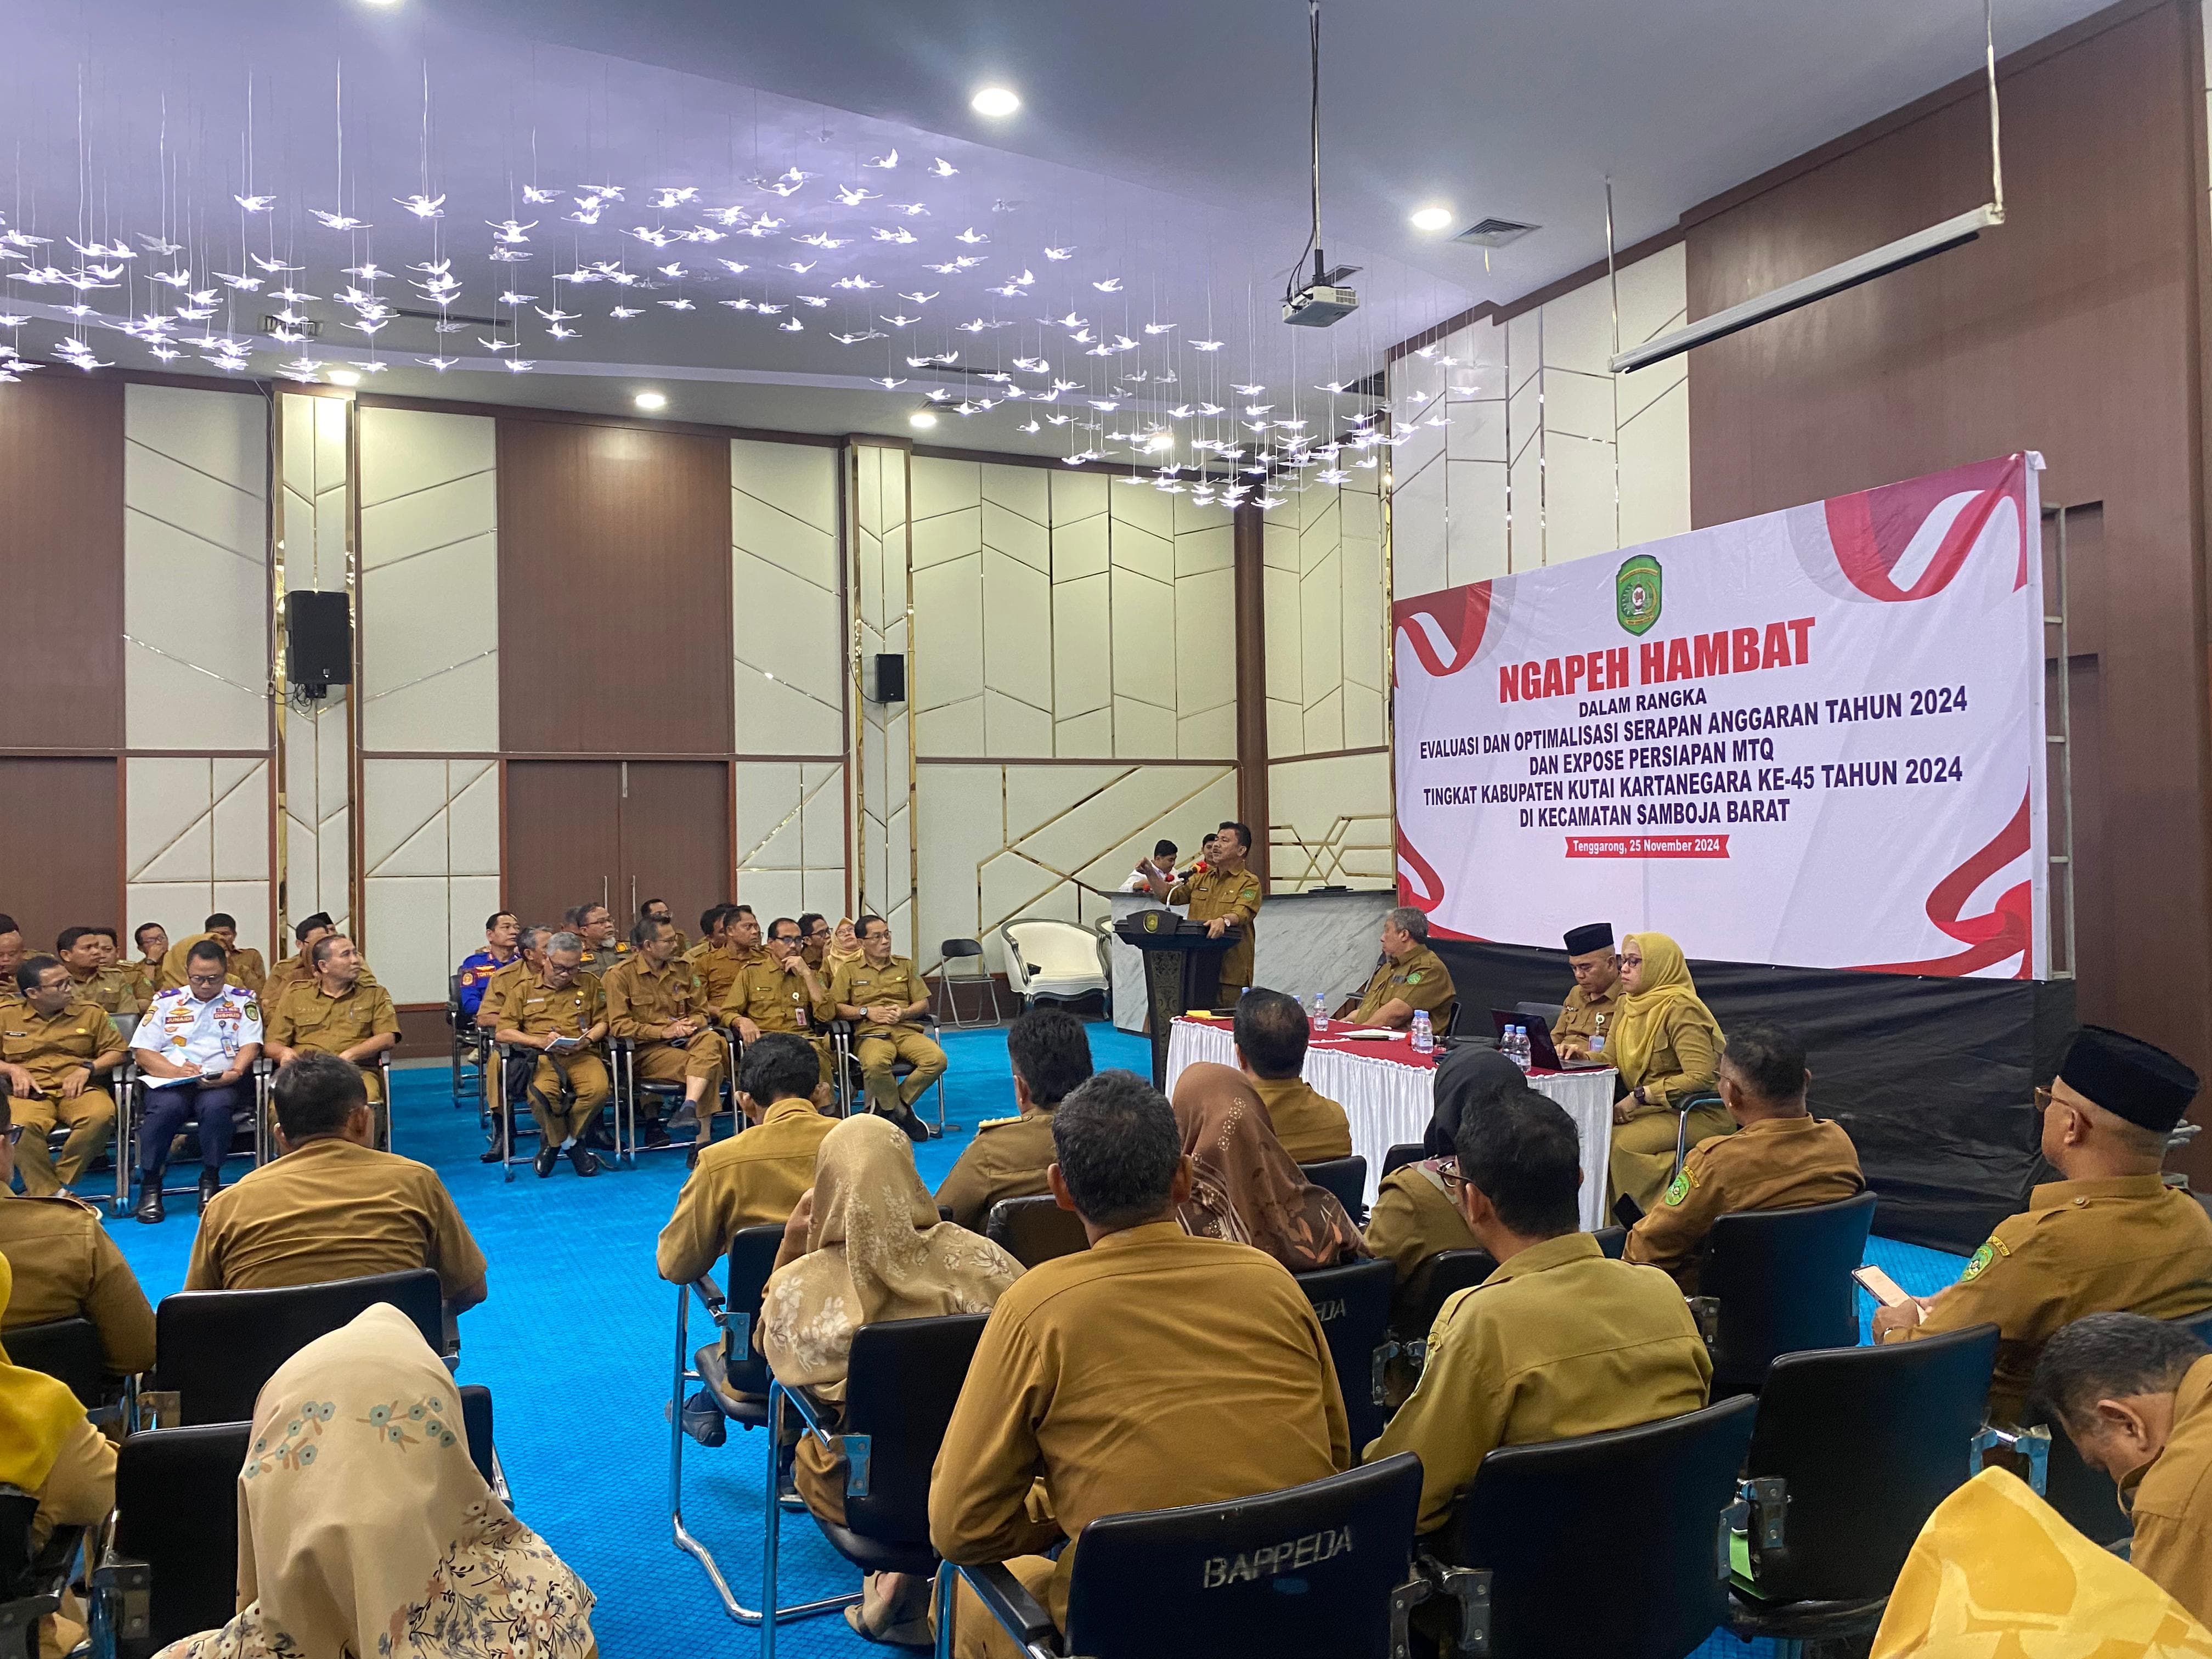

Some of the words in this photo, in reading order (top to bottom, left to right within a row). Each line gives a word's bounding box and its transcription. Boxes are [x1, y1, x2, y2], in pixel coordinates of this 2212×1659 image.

[1500, 647, 1629, 703] NGAPEH
[1640, 617, 1815, 685] HAMBAT
[1420, 736, 1479, 759] EVALUASI
[1483, 733, 1510, 754] DAN
[1514, 722, 1618, 751] OPTIMALISASI
[1624, 713, 1702, 742] SERAPAN
[1708, 701, 1818, 735] ANGGARAN
[1825, 692, 1901, 724] TAHUN
[1910, 685, 1967, 716] 2024
[1579, 696, 1630, 718] DALAM
[1636, 687, 1707, 712] RANGKA
[1530, 754, 1559, 776] DAN
[1564, 749, 1624, 774] EXPOSE
[1629, 741, 1726, 769] PERSIAPAN
[1733, 737, 1774, 762] MTQ
[1423, 786, 1477, 806] TINGKAT
[1481, 781, 1563, 804] KABUPATEN
[1568, 777, 1614, 800] KUTAI
[1620, 770, 1752, 798] KARTANEGARA
[1758, 765, 1814, 791] KE-45
[1821, 760, 1897, 788] TAHUN
[1905, 755, 1963, 784] 2024
[1520, 808, 1533, 827] DI
[1538, 805, 1631, 827] KECAMATAN
[1637, 801, 1721, 825] SAMBOJA
[1727, 798, 1790, 823] BARAT
[1573, 839, 1627, 855] Tenggarong,
[1629, 839, 1641, 852] 25
[1644, 839, 1692, 852] November
[1695, 838, 1720, 851] 2024
[1203, 1525, 1353, 1589] BAPPEDA
